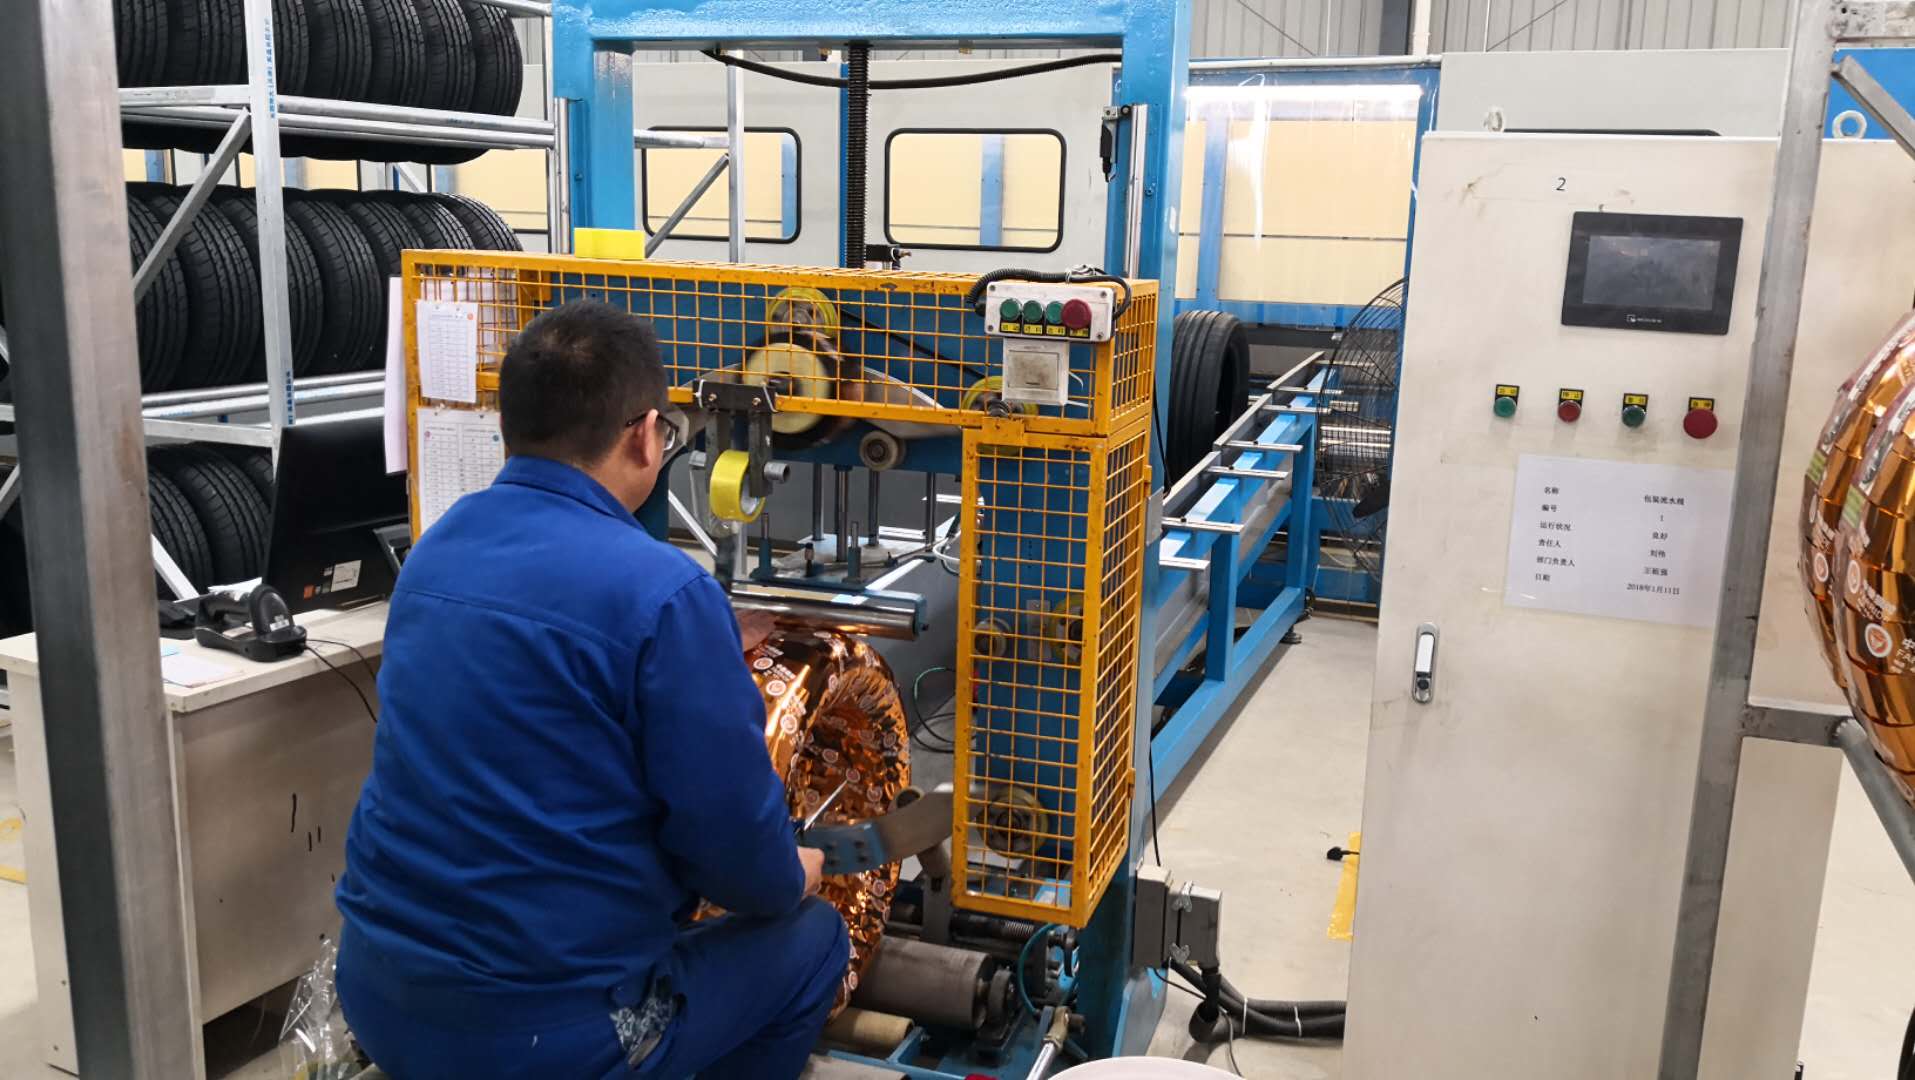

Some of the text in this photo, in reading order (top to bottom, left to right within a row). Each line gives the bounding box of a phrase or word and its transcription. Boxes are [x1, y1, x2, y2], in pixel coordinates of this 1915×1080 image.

[1556, 177, 1567, 191] 2
[1644, 495, 1684, 505] 包装流水线
[1541, 504, 1557, 512] 编号
[1540, 521, 1571, 531] 运行状况
[1652, 532, 1668, 540] 良好
[1538, 538, 1561, 548] 责任人
[1536, 556, 1575, 567] 部门负责人
[1535, 573, 1550, 581] 日期
